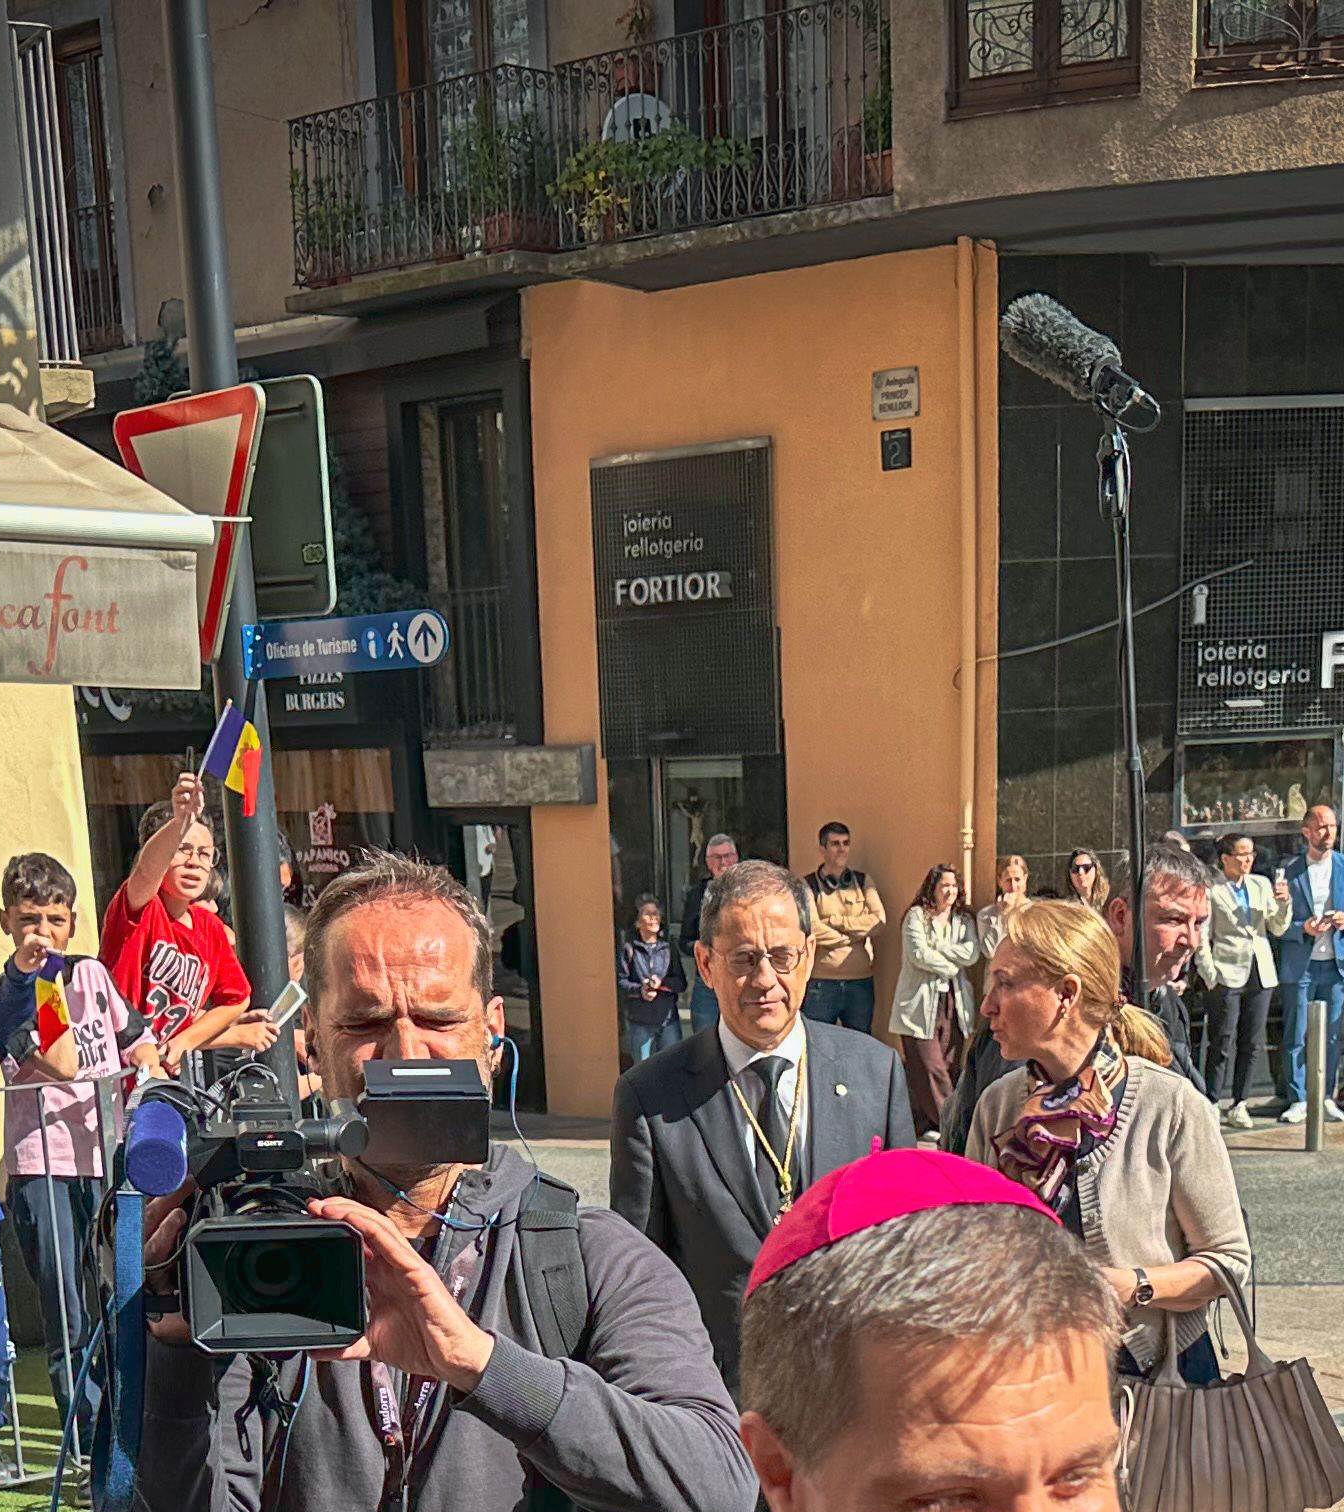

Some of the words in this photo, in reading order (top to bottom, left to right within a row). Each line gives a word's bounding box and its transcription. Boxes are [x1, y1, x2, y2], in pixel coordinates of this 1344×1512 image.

[889, 441, 903, 467] 2
[623, 511, 672, 537] joieria
[624, 532, 704, 558] rellotgeria
[615, 571, 728, 605] FORTIOR
[266, 642, 301, 660] Oficina
[302, 640, 316, 656] de
[316, 637, 357, 655] Turisme
[1197, 640, 1267, 664] joieria
[1197, 662, 1311, 690] rellotgeria
[285, 690, 346, 712] BURGERS
[379, 1387, 393, 1434] Andorra
